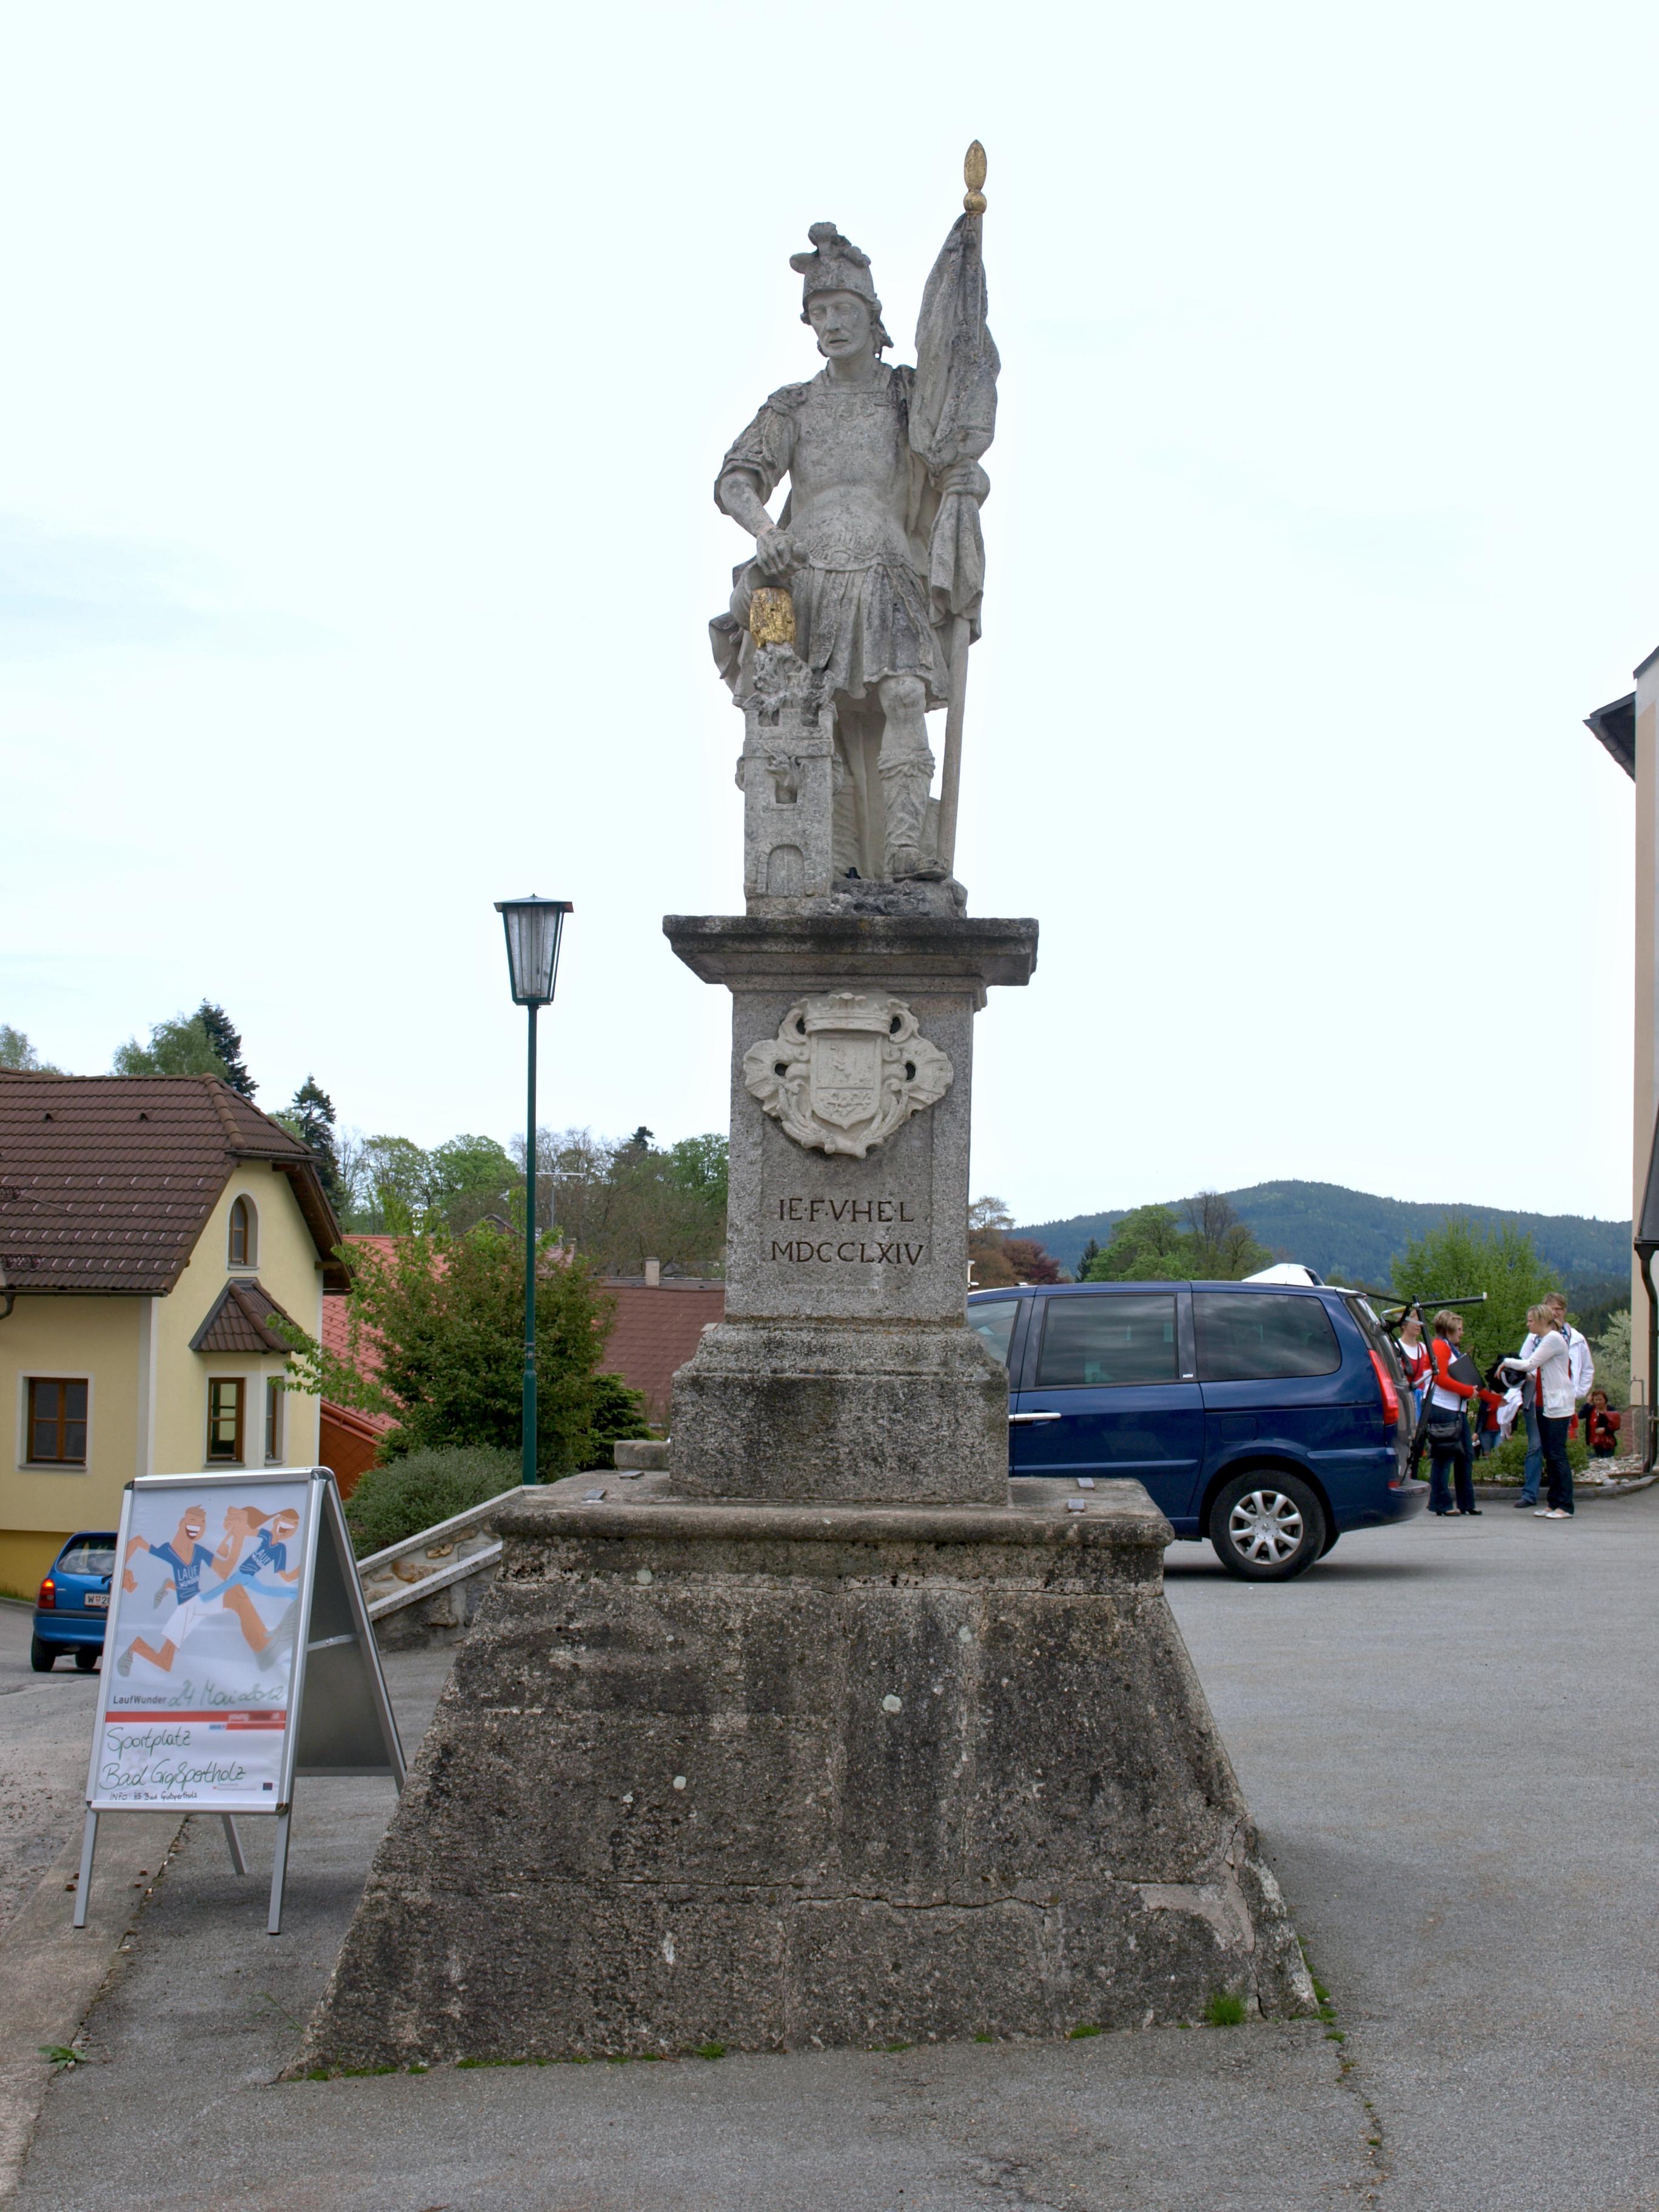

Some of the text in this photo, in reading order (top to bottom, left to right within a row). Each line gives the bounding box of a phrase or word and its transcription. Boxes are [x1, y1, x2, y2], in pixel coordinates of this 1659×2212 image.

[771, 1241, 923, 1265] MDCCLXIV
[255, 1549, 271, 1564] LAUF
[177, 1566, 198, 1581] LAUF
[113, 1695, 167, 1704] LaufWunder
[200, 1679, 235, 1706] Mai
[238, 1683, 284, 1701] 2012
[107, 1726, 192, 1760] Sportplatz
[99, 1763, 148, 1790] Bad
